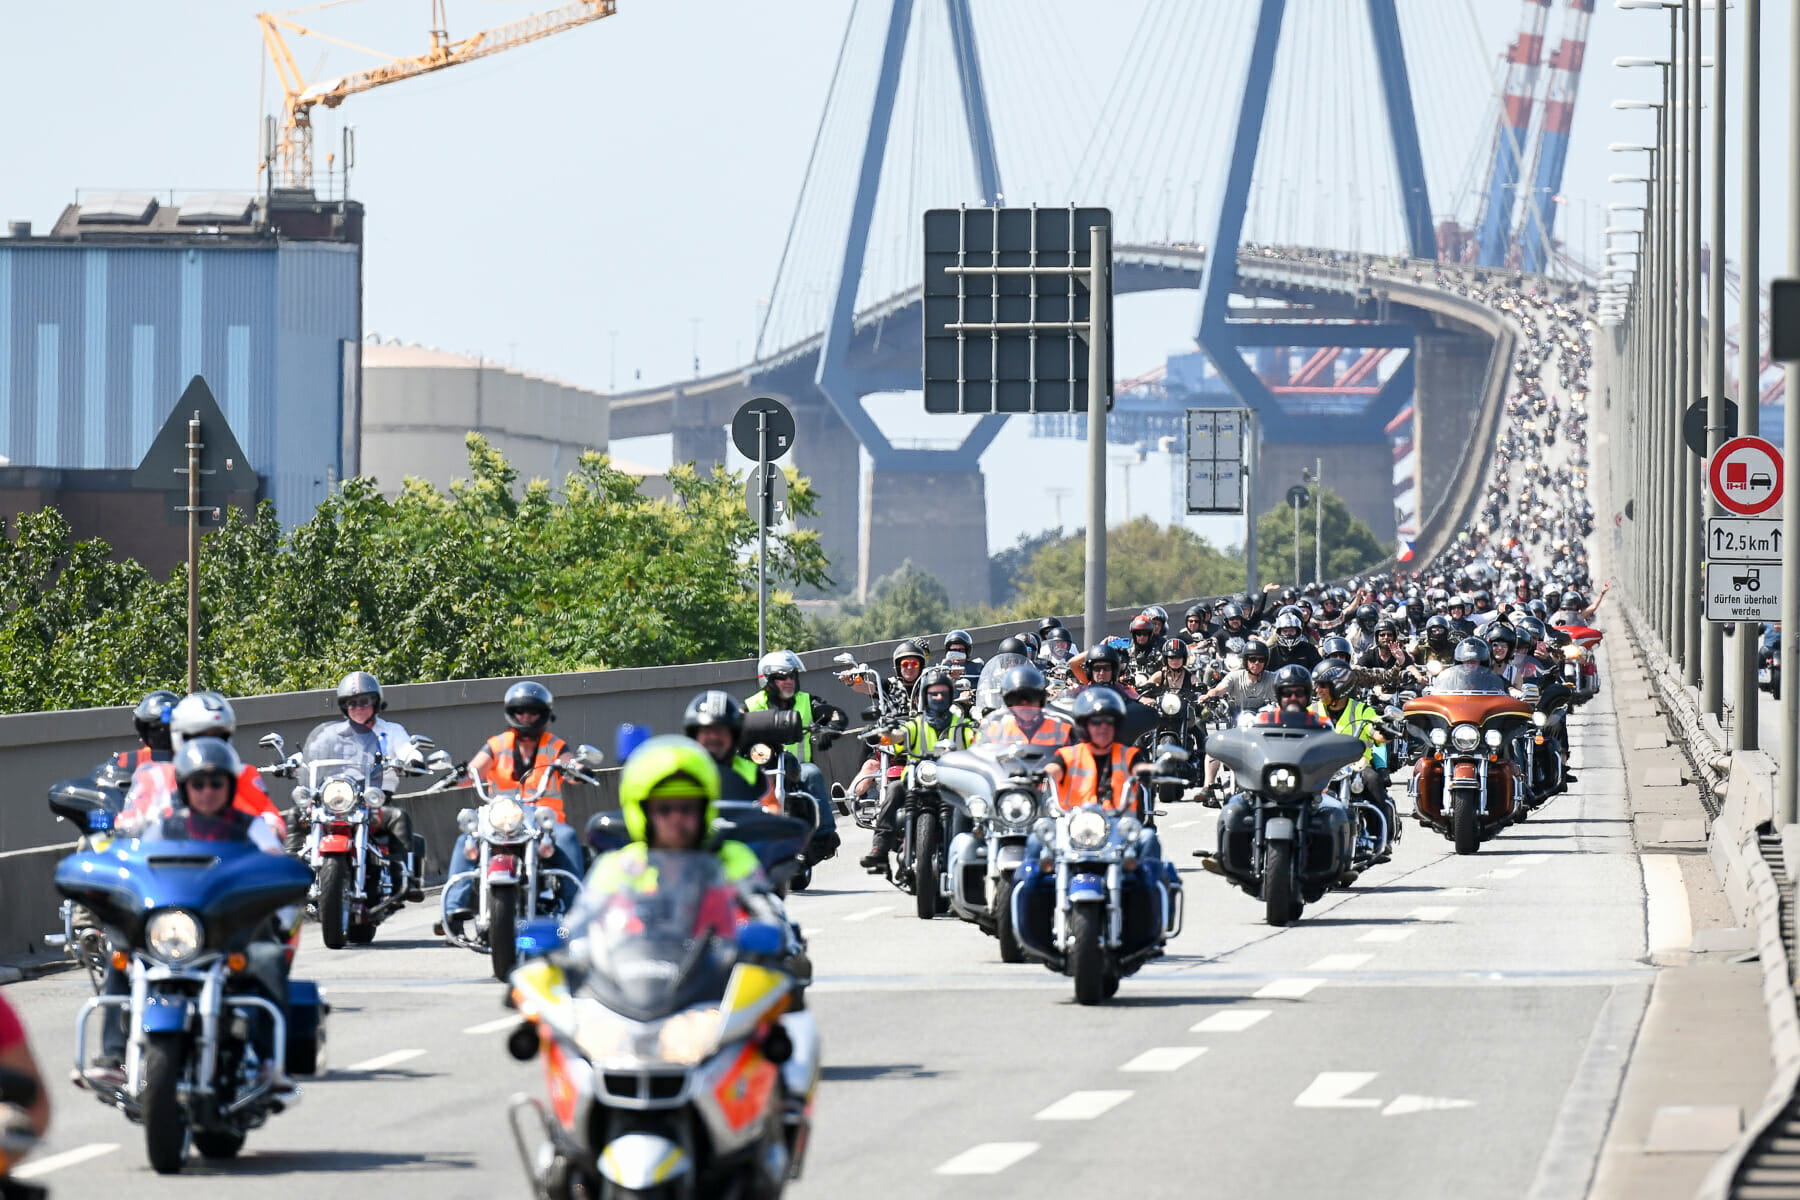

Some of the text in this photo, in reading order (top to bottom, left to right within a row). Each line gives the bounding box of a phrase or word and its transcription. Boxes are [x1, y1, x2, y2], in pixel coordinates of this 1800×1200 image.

[1725, 532, 1769, 551] 2,5 km
[1714, 594, 1778, 605] dürfen überholt
[1731, 607, 1761, 616] werden
